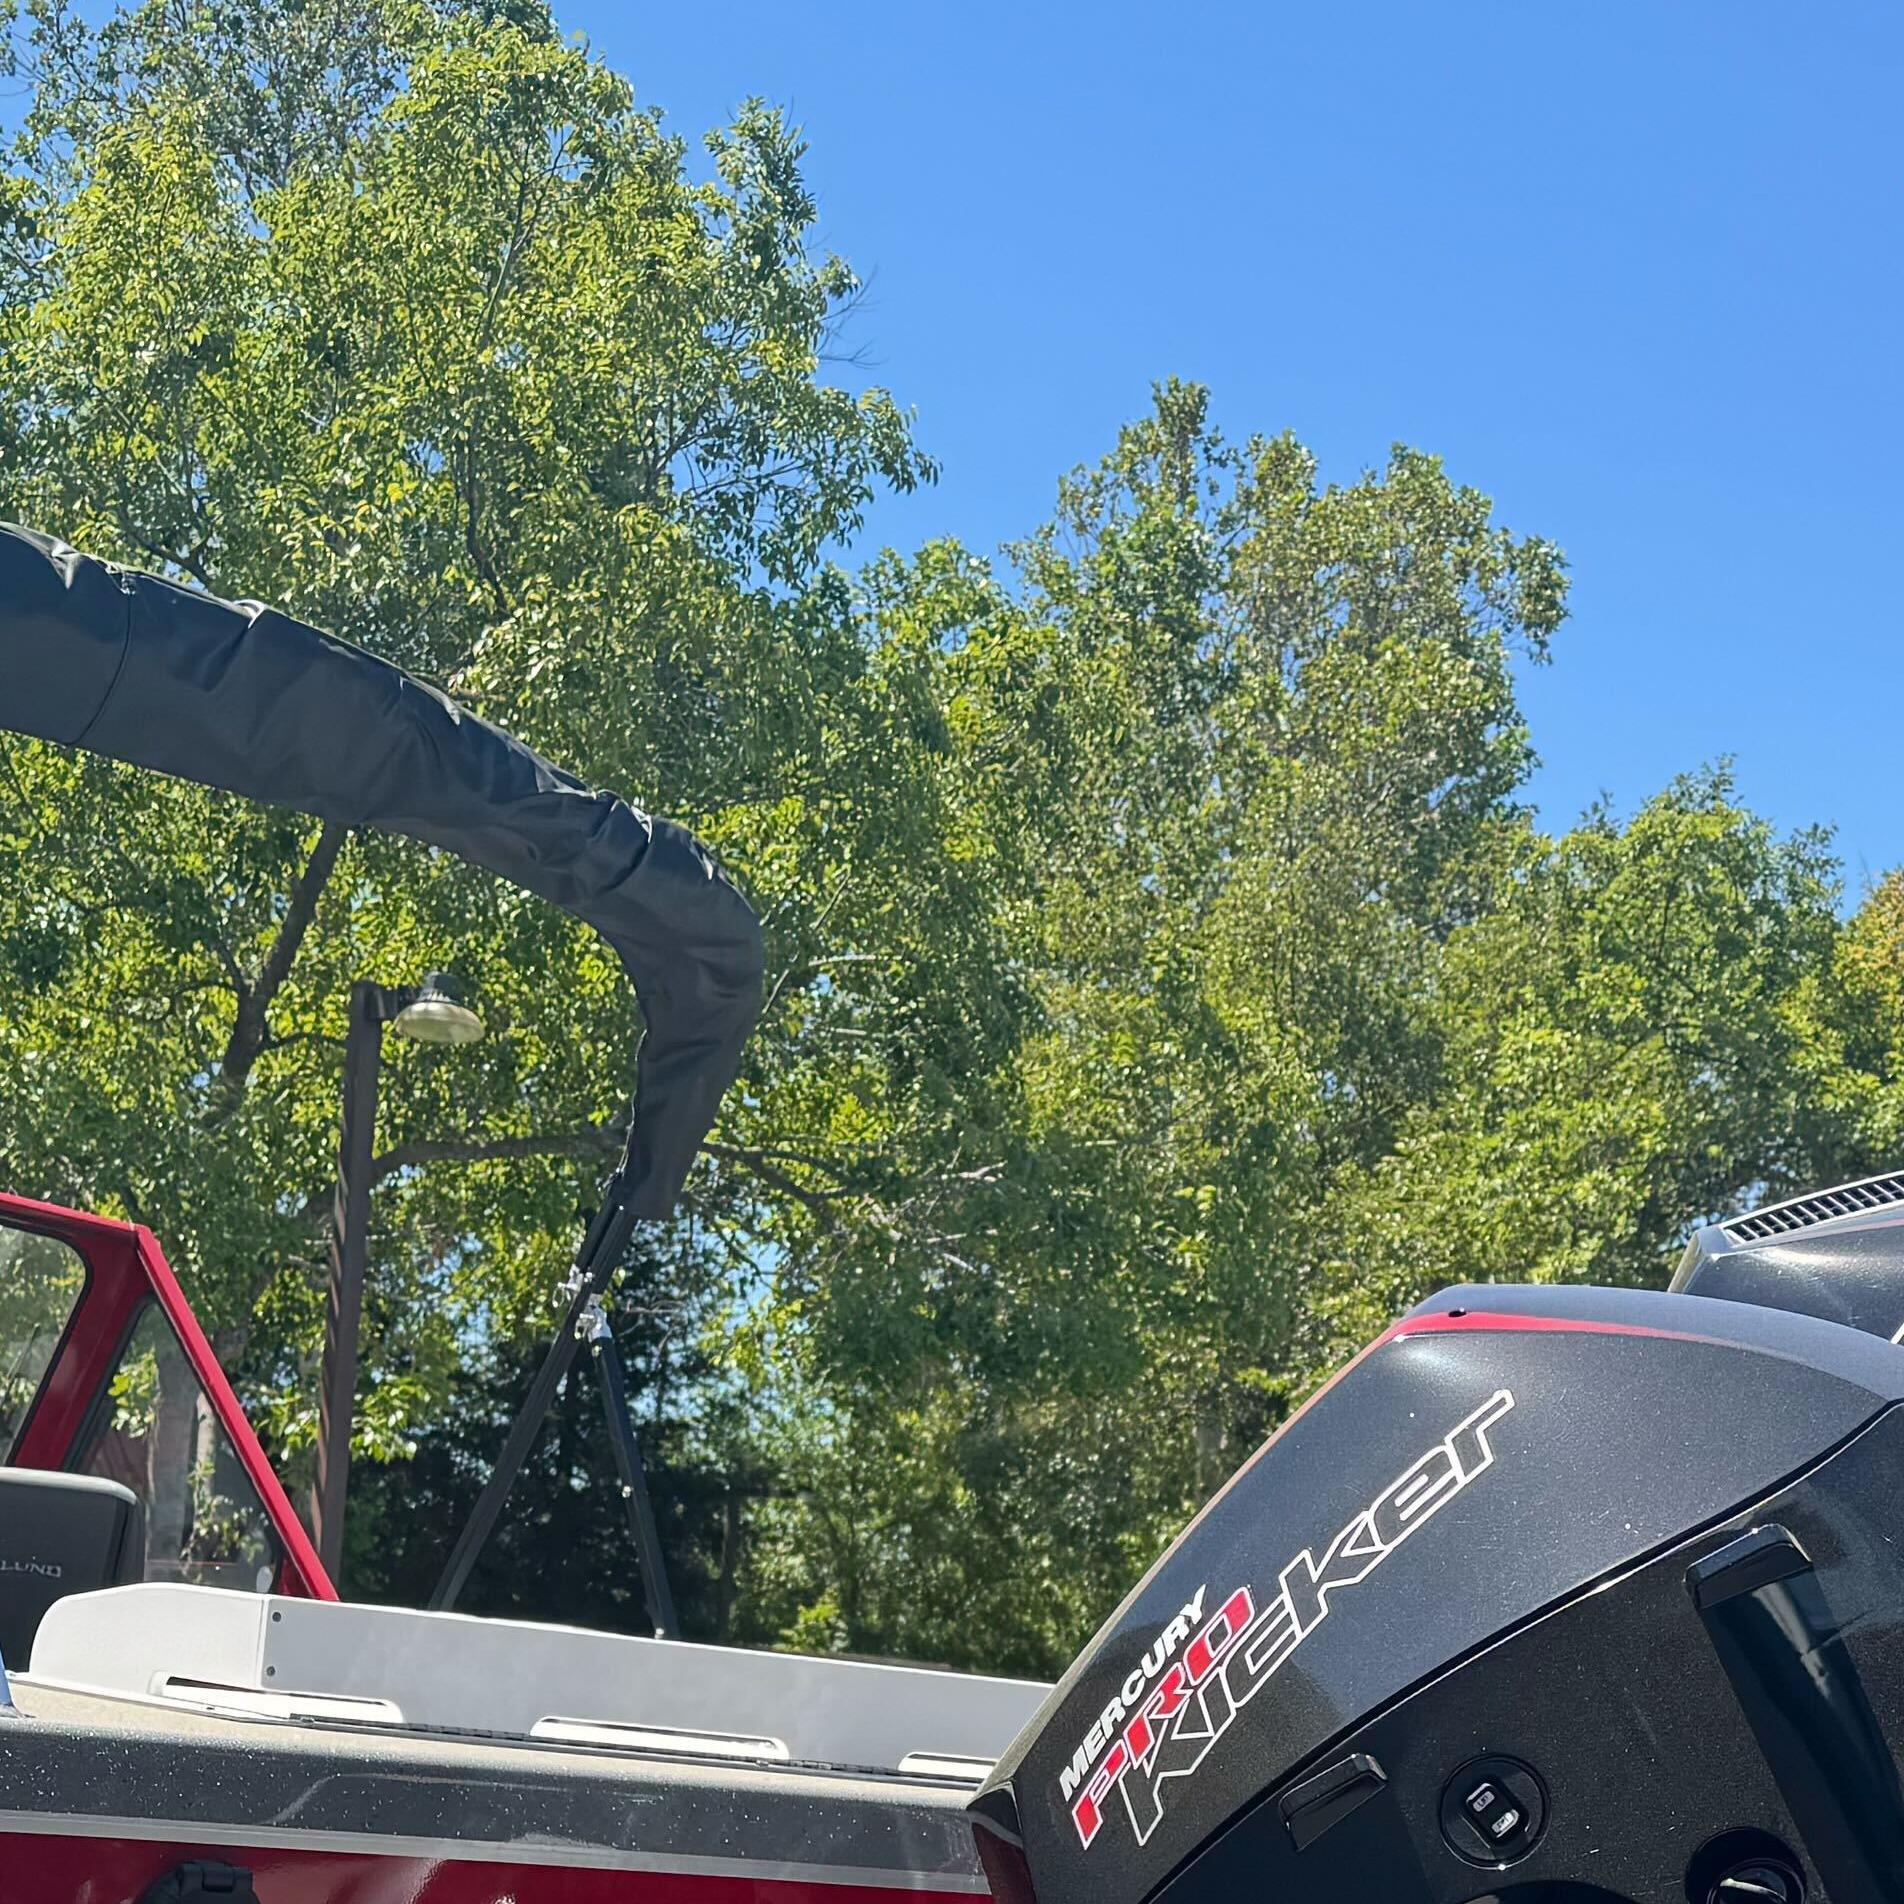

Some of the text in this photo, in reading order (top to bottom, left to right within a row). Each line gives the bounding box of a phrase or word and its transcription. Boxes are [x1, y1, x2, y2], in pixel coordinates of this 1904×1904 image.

[0, 1560, 62, 1578] LUND
[1059, 1583, 1208, 1803] MERCURY
[1071, 1586, 1256, 1851] PRO
